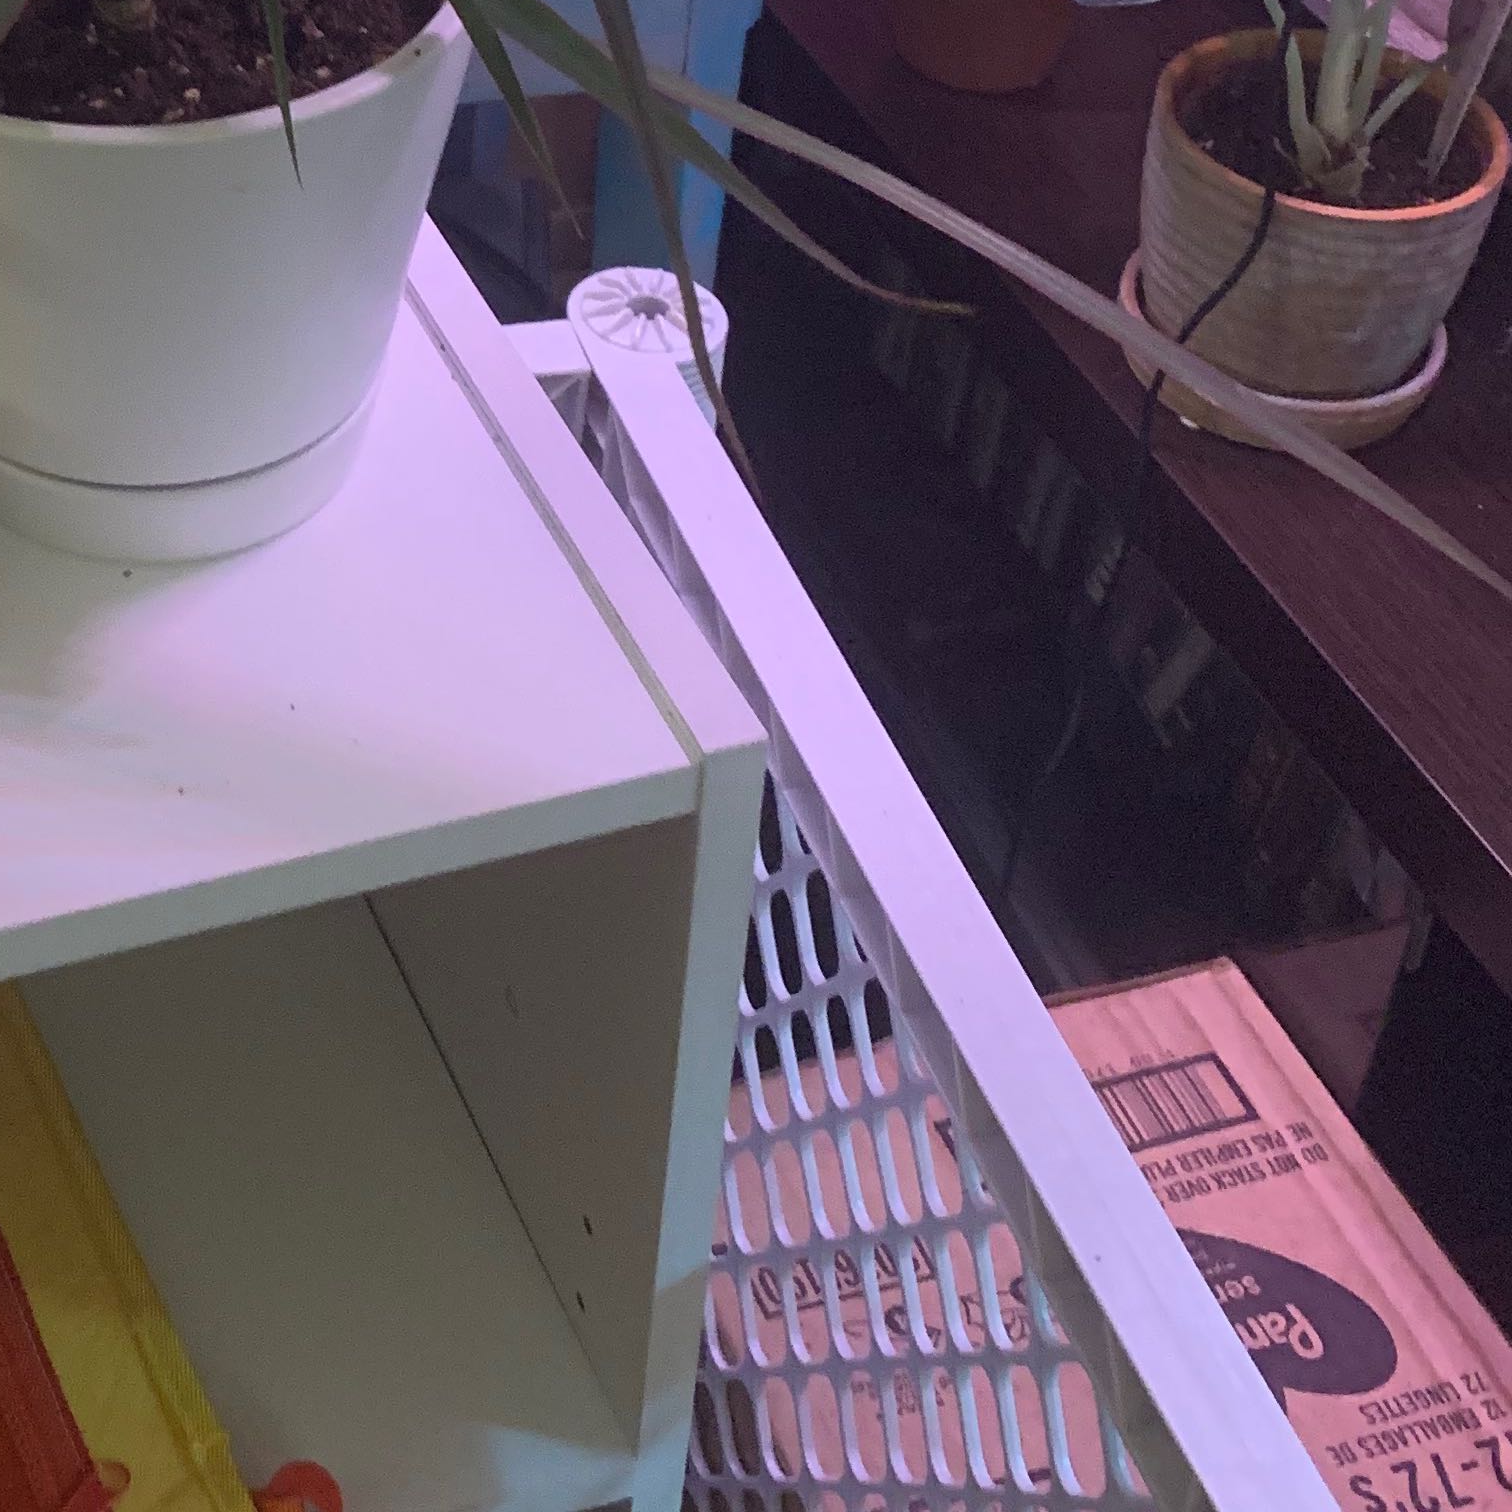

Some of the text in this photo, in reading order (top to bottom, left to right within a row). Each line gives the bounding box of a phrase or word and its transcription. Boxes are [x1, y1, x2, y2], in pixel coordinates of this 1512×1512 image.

[1140, 1121, 1313, 1183] NE PAS EMPILER PLU
[1162, 1142, 1329, 1203] DO NOT STACK OVER
[1358, 1381, 1462, 1425] LINGETTES
[1325, 1441, 1359, 1468] DE
[1357, 1406, 1482, 1459] EMBALLAGES
